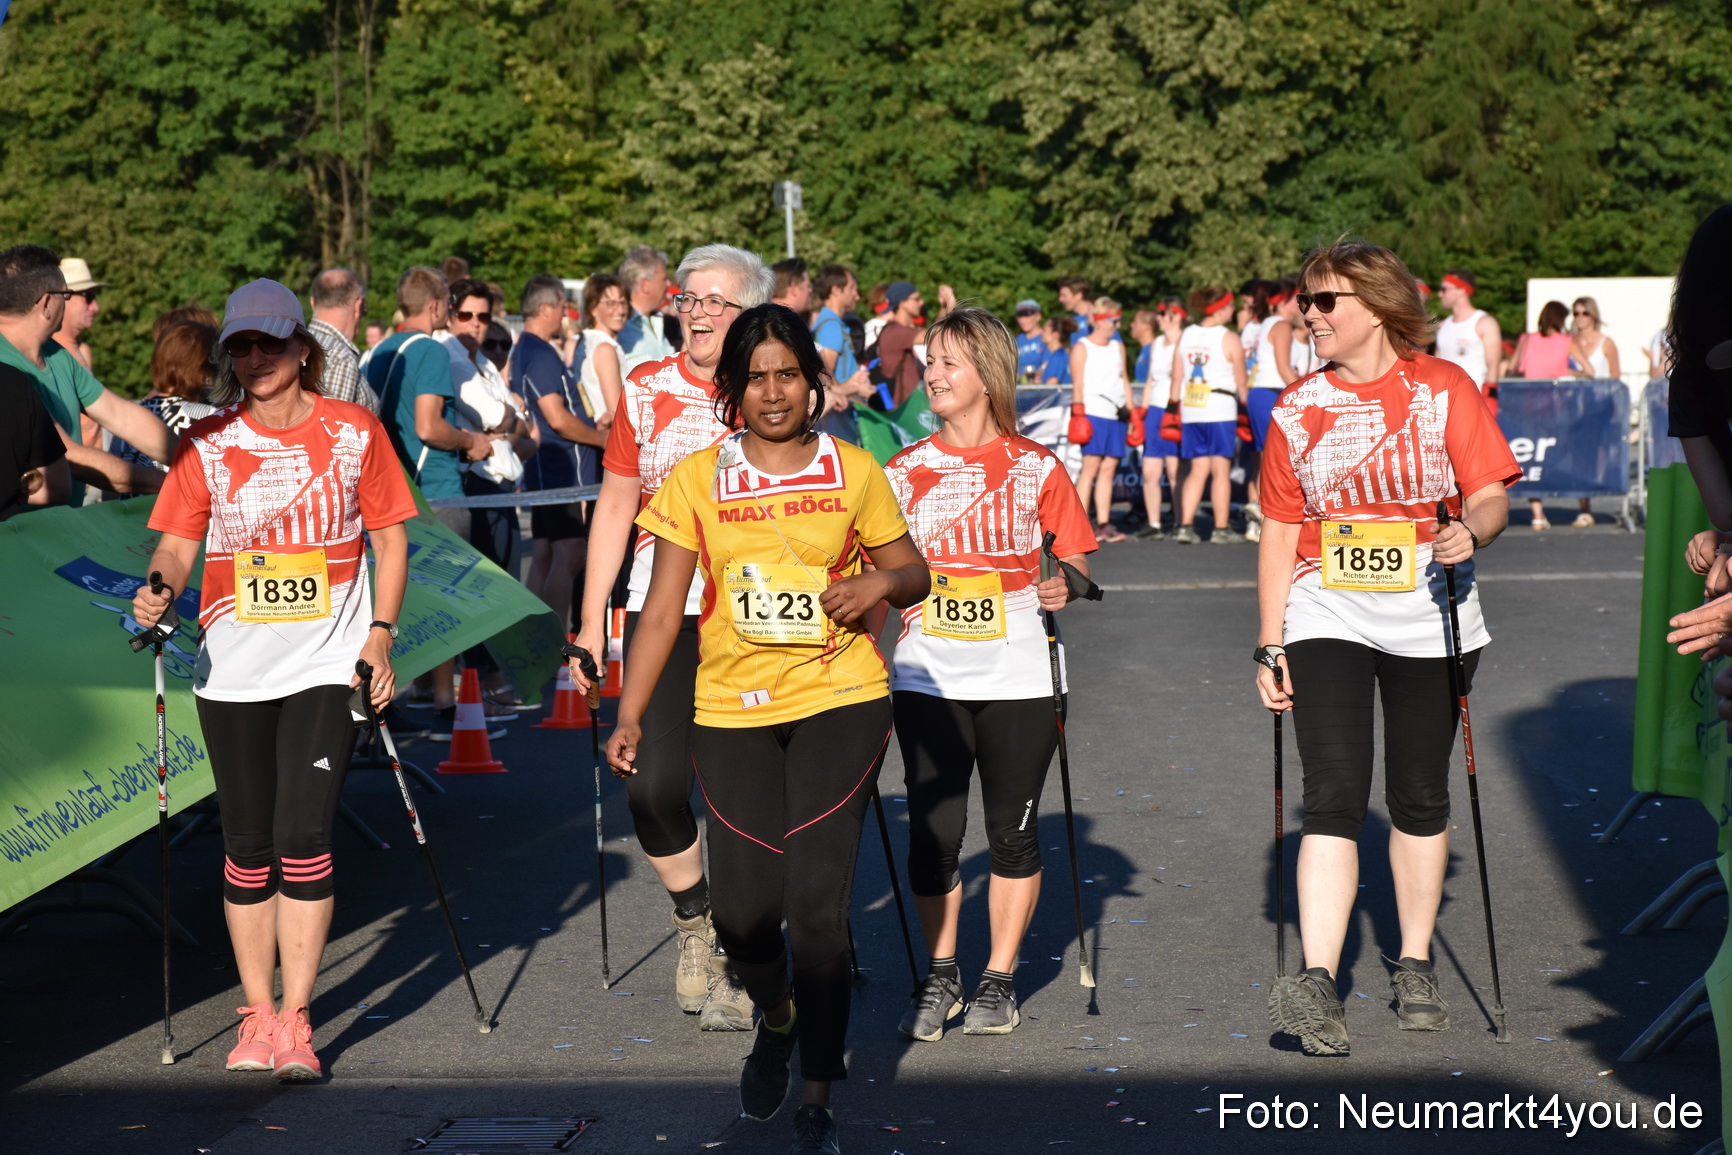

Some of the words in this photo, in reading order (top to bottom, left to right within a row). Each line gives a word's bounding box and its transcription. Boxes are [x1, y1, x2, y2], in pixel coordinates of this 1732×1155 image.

[682, 388, 704, 399] 10.54
[1283, 389, 1318, 403] 9.0276
[1331, 396, 1357, 406] 10.54
[676, 426, 700, 436] 52.01
[1330, 423, 1358, 434] 24.87
[254, 442, 280, 451] 10.54
[673, 439, 699, 449] 26.22
[1330, 436, 1357, 447] 52.01
[1329, 450, 1358, 462] 26.22
[257, 479, 285, 488] 52.01
[935, 481, 960, 490] 24.87
[259, 492, 287, 502] 26.22
[935, 493, 959, 501] 52.01
[718, 504, 776, 523] MAX
[784, 495, 848, 517] BÖGL
[934, 504, 960, 513] 26.22
[1333, 532, 1364, 540] firmenlauf
[1333, 546, 1403, 572] 1859
[246, 563, 277, 571] firmenlauf
[736, 575, 772, 583] firmeuf
[1343, 571, 1368, 579] Richter
[1370, 573, 1393, 581] Agnes
[247, 576, 317, 603] 1839
[251, 603, 287, 611] Dörrmann
[289, 602, 316, 611] Andrea
[737, 591, 814, 621] 1323
[932, 595, 995, 623] 1838
[931, 624, 952, 633] Sparkasse
[939, 620, 966, 630] Deyerler
